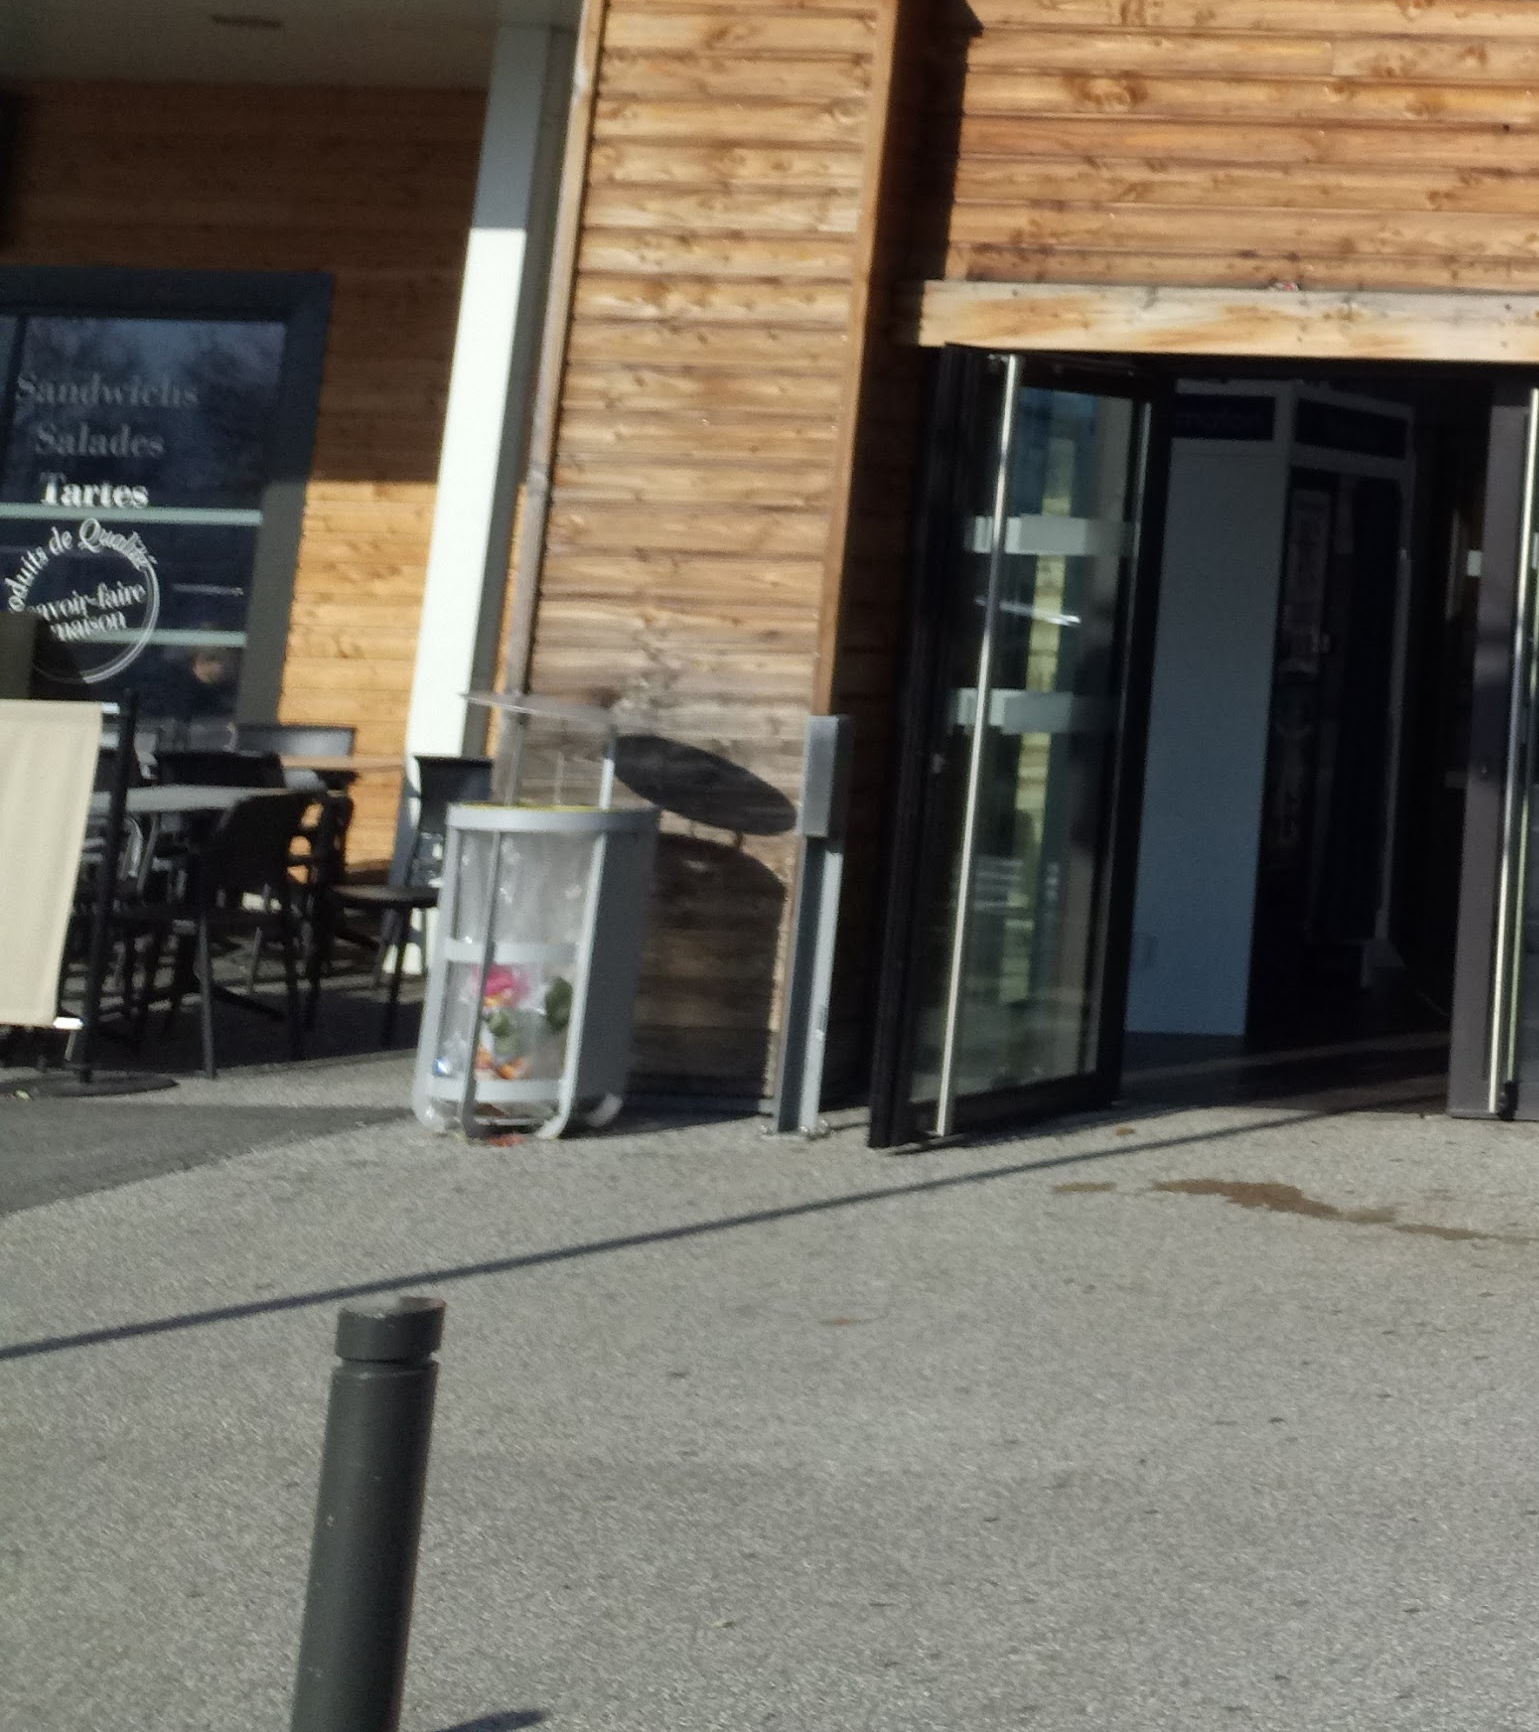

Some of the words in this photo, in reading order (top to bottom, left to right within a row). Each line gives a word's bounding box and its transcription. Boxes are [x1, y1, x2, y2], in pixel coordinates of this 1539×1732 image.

[35, 422, 165, 459] Salades
[40, 471, 150, 509] Tartes
[48, 525, 73, 556] de
